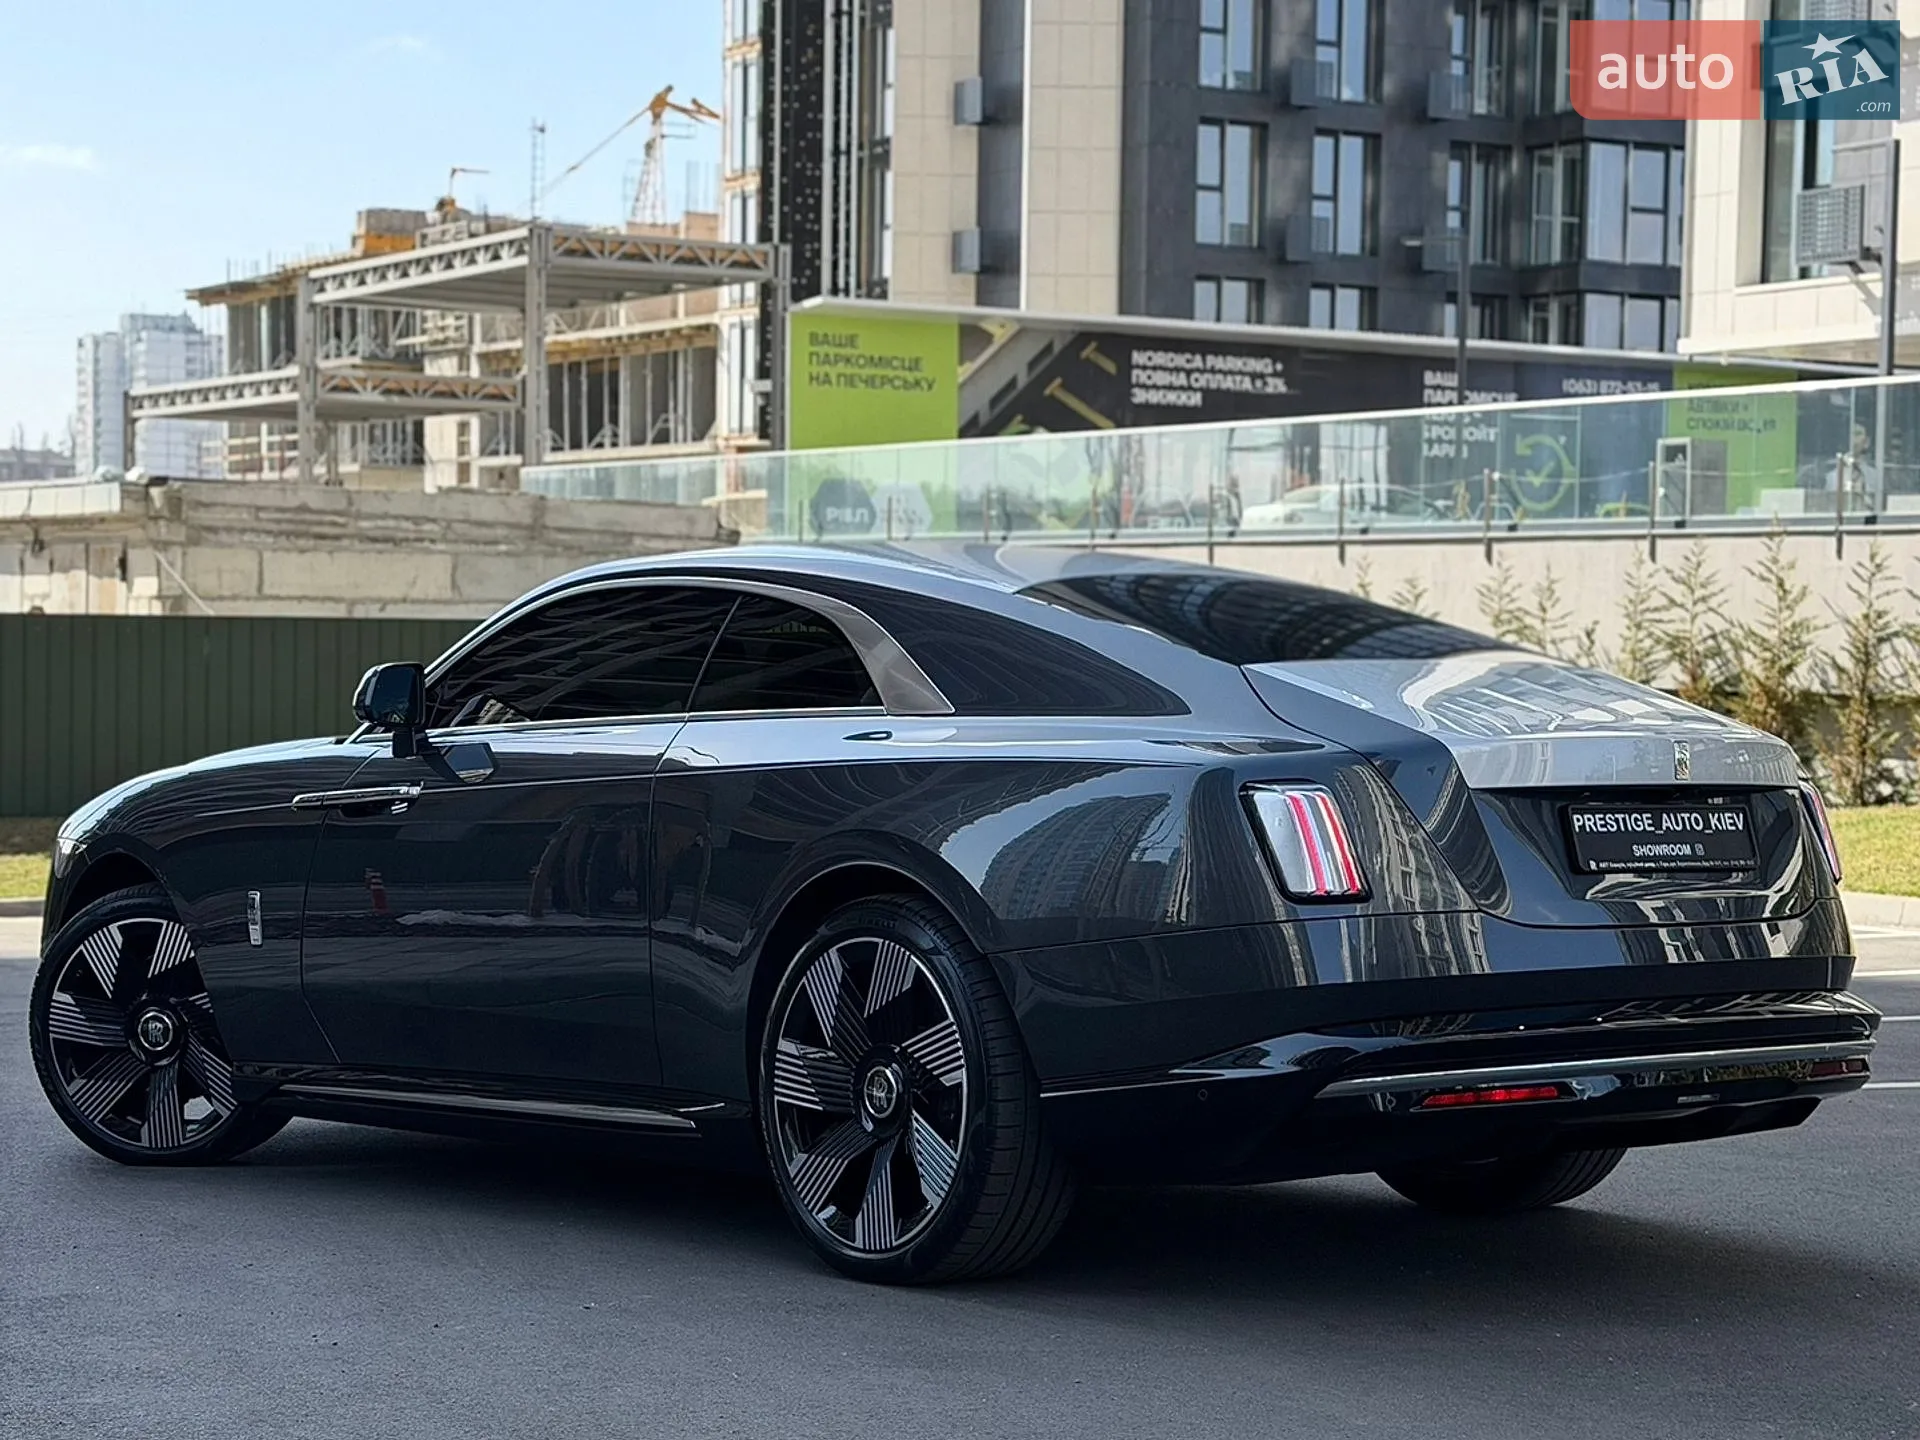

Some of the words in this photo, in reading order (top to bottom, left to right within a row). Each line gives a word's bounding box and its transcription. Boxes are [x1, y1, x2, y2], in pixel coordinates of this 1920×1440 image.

[808, 332, 859, 349] ВАШЕ
[808, 352, 923, 372] ПАРКОМІСЦЕ
[1131, 350, 1203, 369] NORDICA
[1205, 355, 1273, 374] PARKING
[808, 372, 832, 387] НА
[837, 372, 937, 392] ПЕЧЕРСЬКУ
[1131, 368, 1188, 387] ПОВНА
[1189, 372, 1252, 391] ОПЛАТА
[1424, 370, 1458, 388] ВАШ
[1573, 812, 1744, 834] PRESTIGE_AUTO_KIEV
[1632, 844, 1692, 856] SHOWROOM
